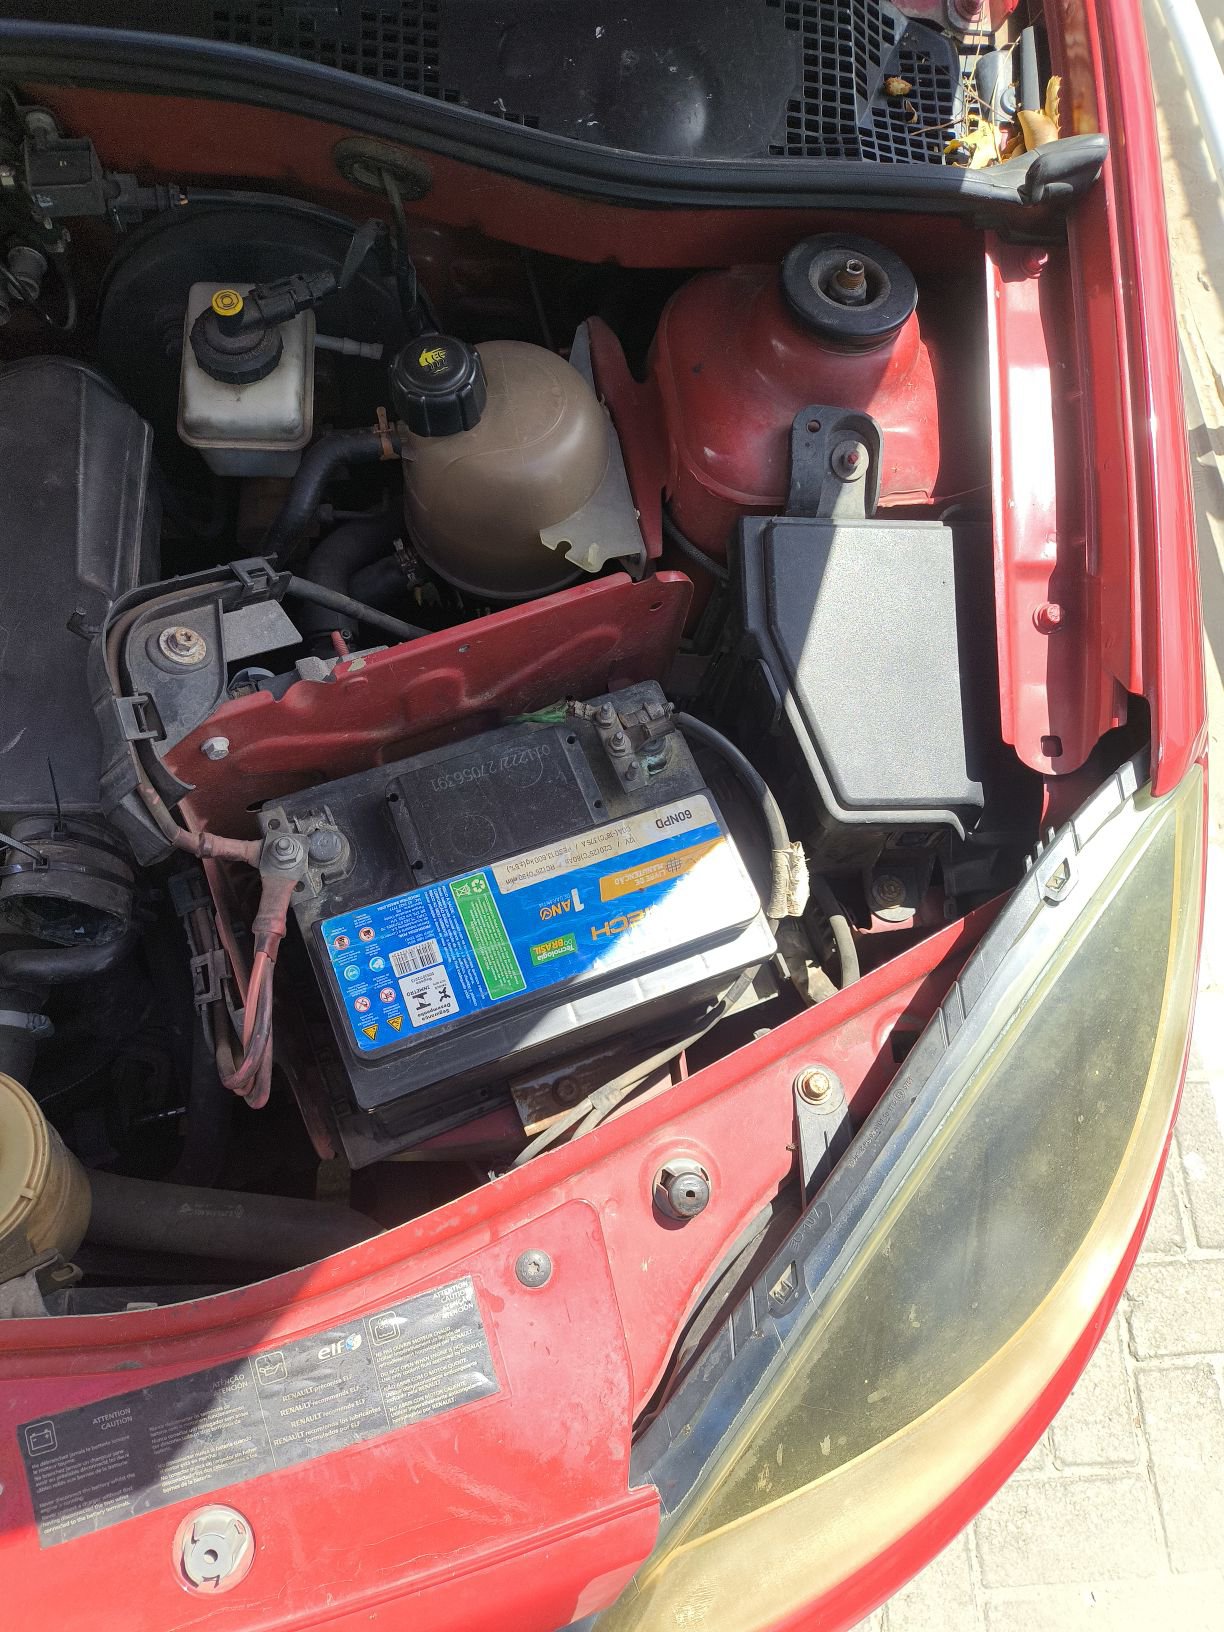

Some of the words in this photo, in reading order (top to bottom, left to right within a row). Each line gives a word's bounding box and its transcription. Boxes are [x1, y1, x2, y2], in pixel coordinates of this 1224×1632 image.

[654, 808, 692, 829] 60NPD
[634, 876, 646, 886] DE
[568, 887, 585, 912] 1
[532, 938, 564, 955] BRASIL
[536, 942, 574, 962] Tecnologia
[405, 985, 430, 996] INMETRO
[440, 1287, 468, 1303] CAUTIO
[317, 1339, 343, 1358] elf
[282, 1386, 314, 1402] RENAULT
[91, 1407, 130, 1425] ATTENTION
[279, 1401, 311, 1416] RENAULT
[100, 1415, 133, 1430] CAUTION
[290, 1412, 322, 1428] RENAULT
[273, 1430, 305, 1446] RENAULT
